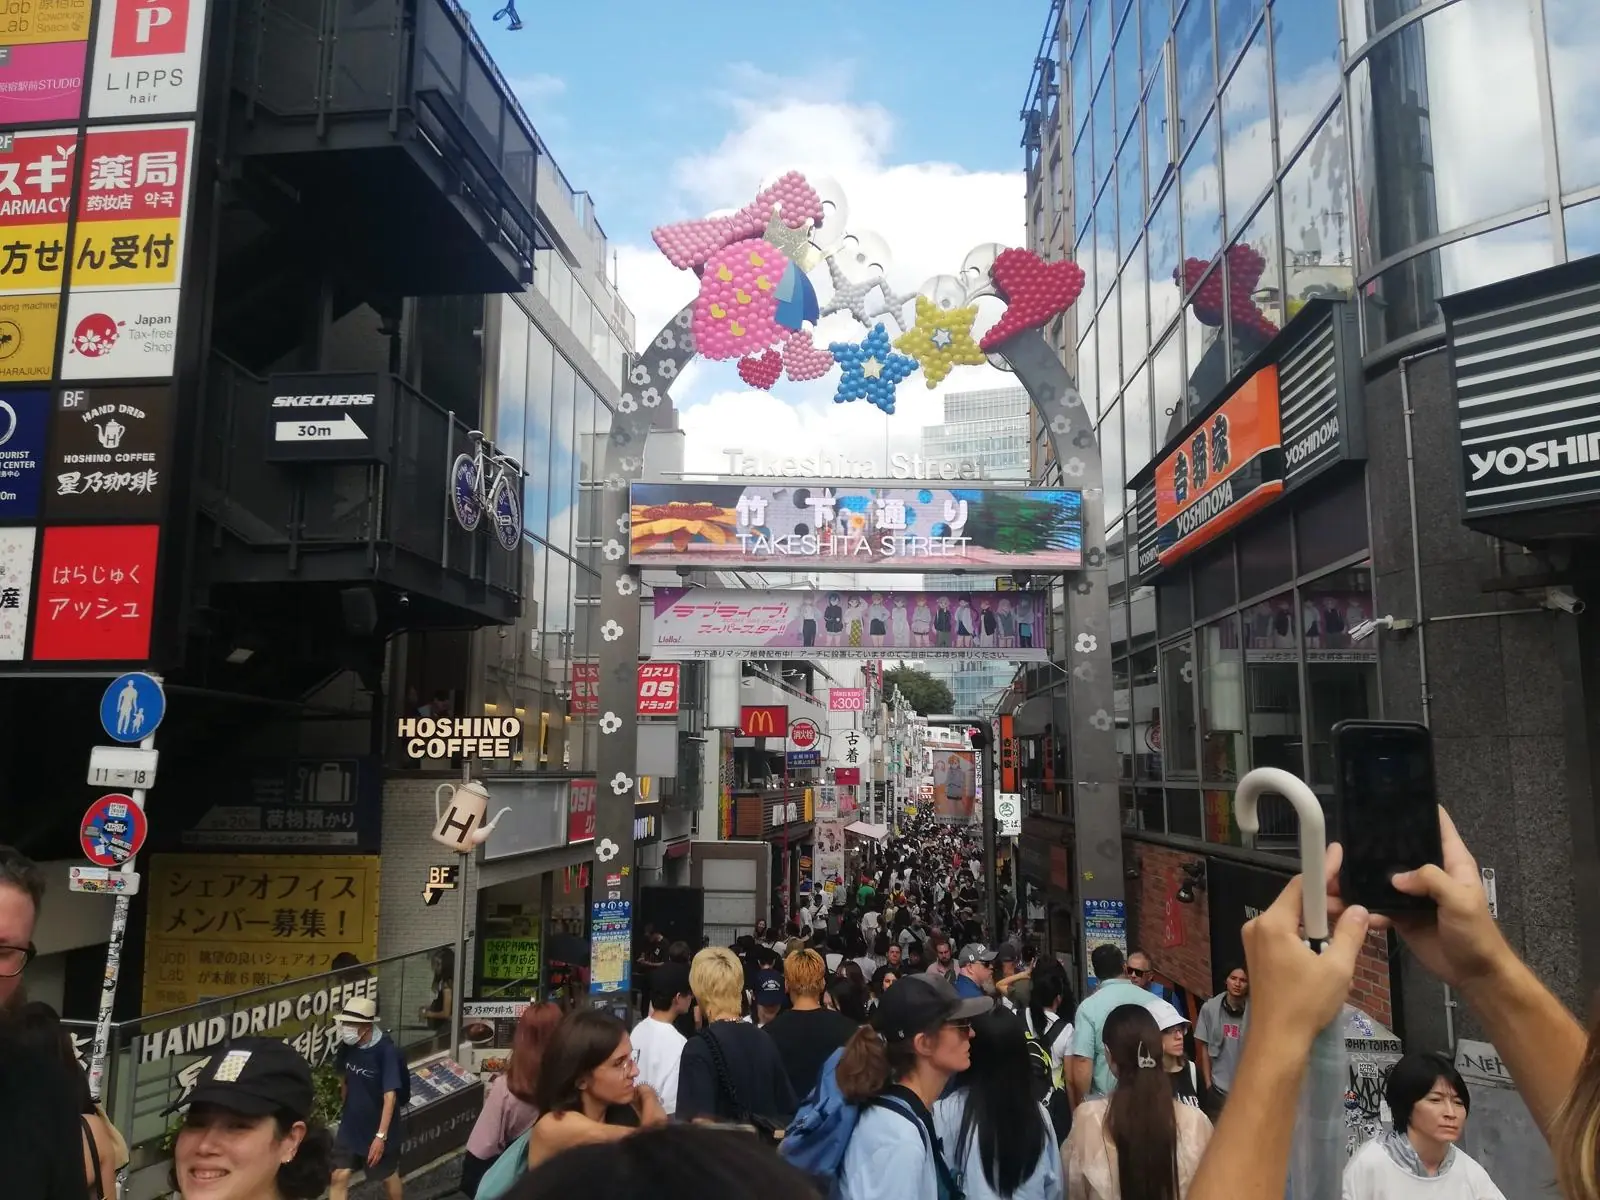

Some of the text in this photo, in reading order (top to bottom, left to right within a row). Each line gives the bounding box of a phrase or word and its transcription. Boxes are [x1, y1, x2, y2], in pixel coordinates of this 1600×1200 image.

[106, 68, 183, 91] LIPPS
[129, 92, 158, 105] hair
[89, 151, 178, 192] 薬局
[87, 194, 132, 212] 药妆店
[145, 192, 175, 209] 약국
[77, 233, 174, 271] ん受付
[135, 314, 172, 327] Japan
[129, 328, 174, 340] Tax-free
[143, 342, 172, 354] Shop
[63, 391, 84, 407] BF
[271, 393, 376, 407] SKECHERS
[82, 404, 146, 423] HAND DRIP
[298, 425, 331, 437] 30m
[1284, 415, 1340, 469] YOSHINOYA
[3, 460, 35, 470] CENTER
[63, 452, 155, 464] HOSHINO COFFEE
[722, 447, 990, 480] Takeshita Street
[1173, 413, 1231, 506] 吉野家
[56, 468, 158, 496] 星乃珈琲
[736, 495, 968, 530] 竹下通り
[1176, 479, 1233, 537] YOSHINOYA
[736, 534, 973, 556] TAKESHITA STREET
[52, 564, 141, 585] はらじゅく
[48, 596, 140, 621] アッシュ
[641, 666, 673, 677] クスリ
[640, 681, 675, 697] OS
[640, 700, 674, 709] ドラッグ
[397, 717, 522, 738] HOSHINO
[407, 738, 510, 759] COFFEE
[845, 731, 860, 763] 古着
[95, 768, 109, 782] 11
[133, 770, 146, 785] 18
[266, 809, 355, 829] 荷物預かり
[430, 866, 451, 884] BF
[169, 872, 356, 900] シェアオフィス
[140, 1016, 226, 1064] HAND
[230, 999, 293, 1039] DRIP
[296, 976, 378, 1021] COFFEE
[345, 1061, 375, 1079] NYC
